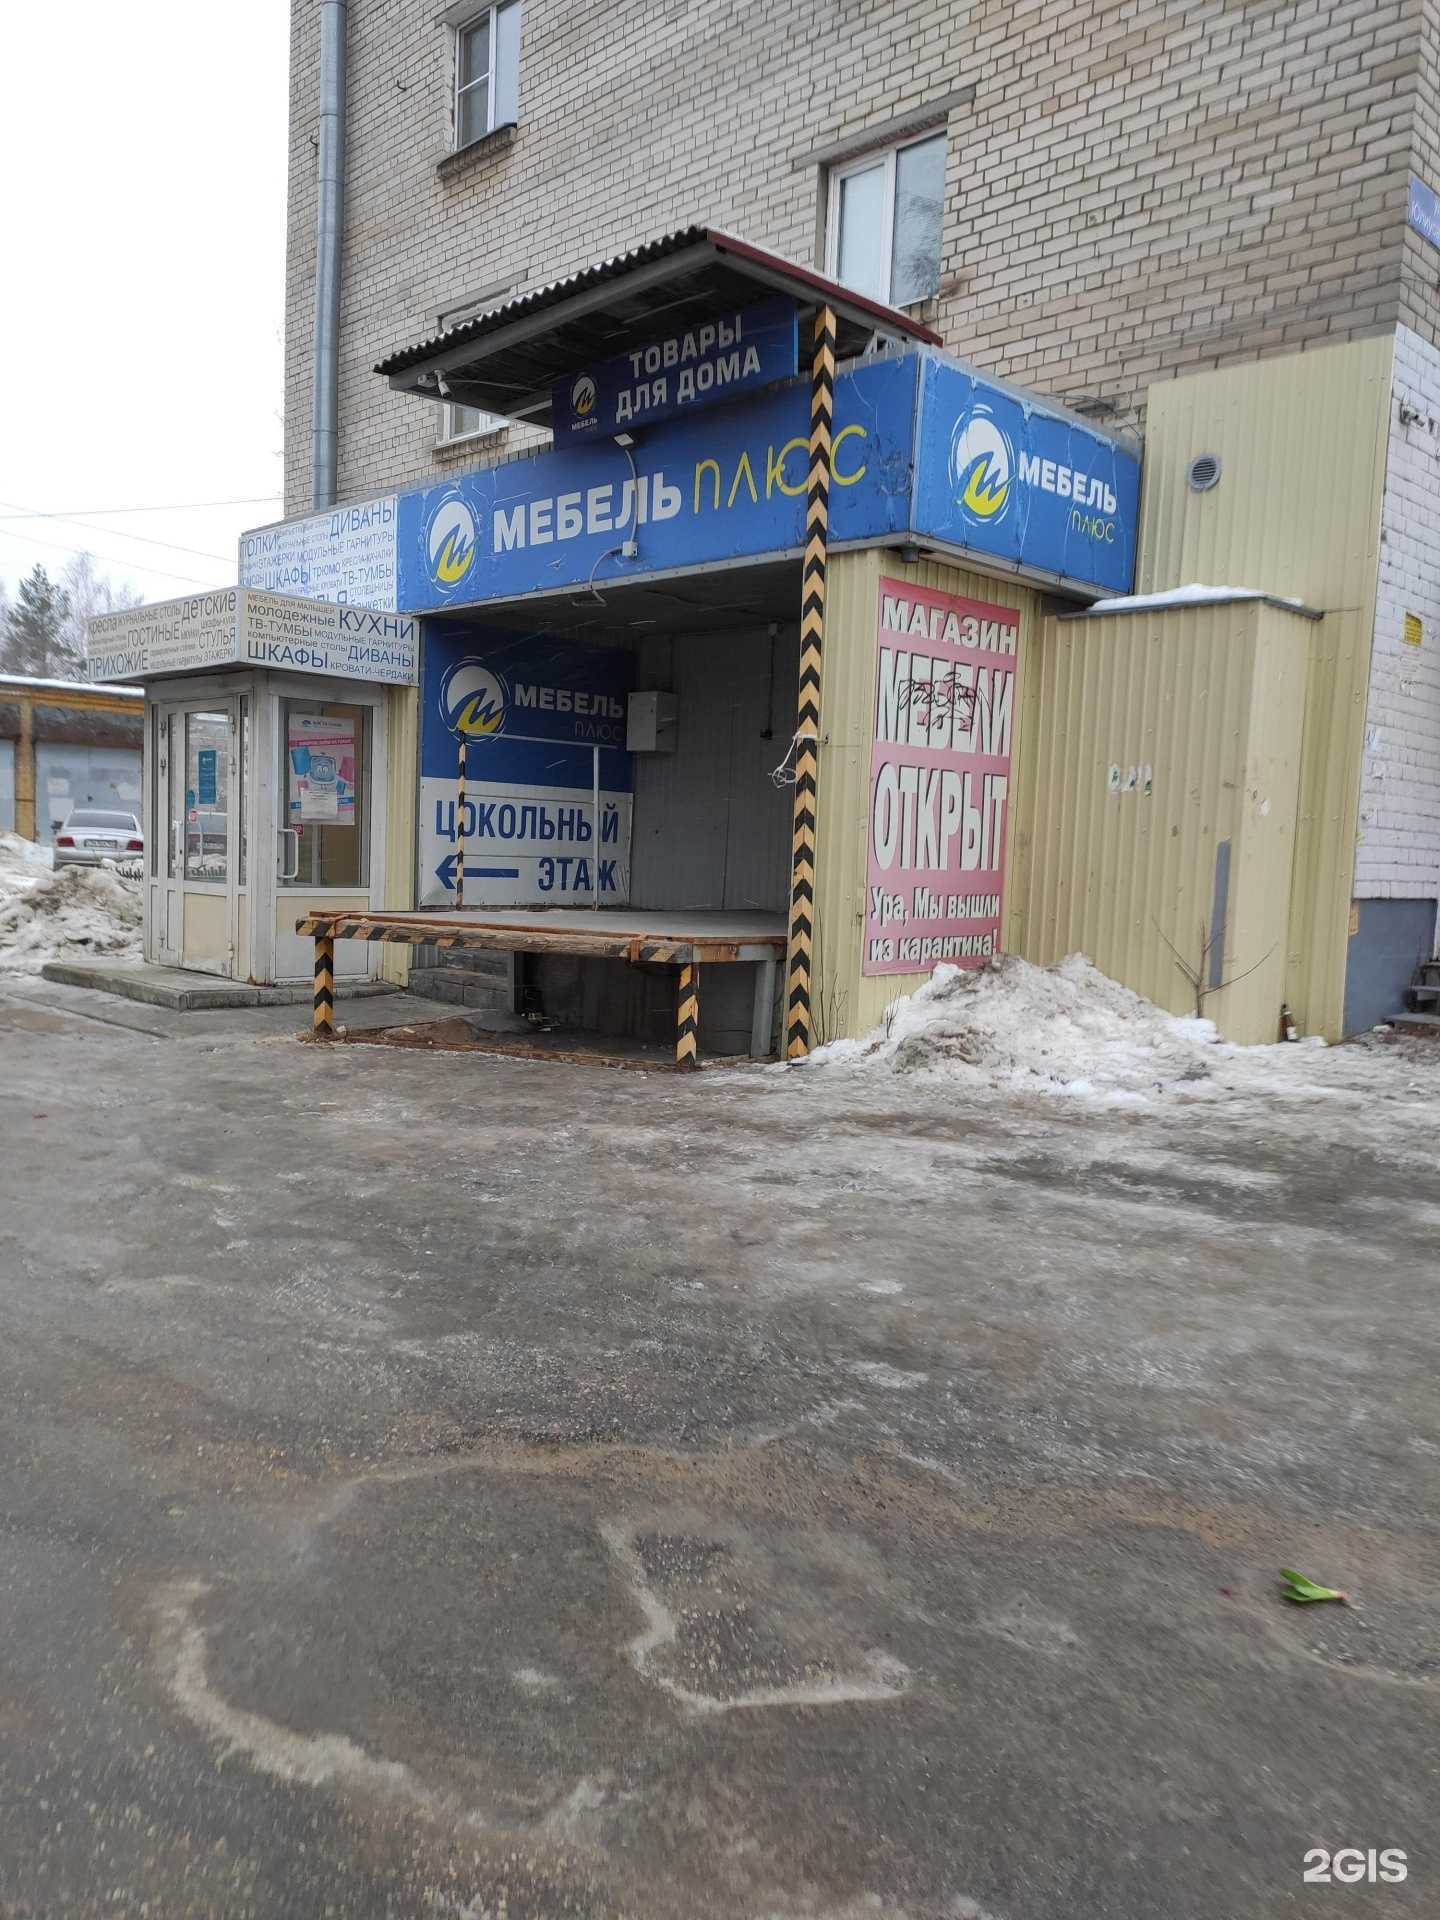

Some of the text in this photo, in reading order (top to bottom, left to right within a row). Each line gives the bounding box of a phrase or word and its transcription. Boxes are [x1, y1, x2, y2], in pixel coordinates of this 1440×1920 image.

[629, 315, 743, 378] ТОВАРЫ
[616, 345, 761, 424] ДЛЯ ДОМА
[571, 417, 598, 431] МЕБЕЛЬ
[493, 424, 867, 553] МЕБЕЛЬ ПЛЮС
[1018, 450, 1117, 514] МЕБЕЛЬ
[330, 498, 395, 541] ДИВАНЫ
[1072, 509, 1115, 544] ПЛЮС
[297, 540, 344, 564] МОДУЛЬНЫЕ
[346, 528, 395, 550] ГАРНИТУРЫ
[264, 562, 311, 591] ШКАФЫ
[343, 561, 394, 585] ТВ-ТУМБЫ
[181, 591, 237, 626] детские
[248, 593, 335, 615] МЕБЕЛЬ ДЛЯ МАЛЫШЕЙ
[127, 621, 181, 648] ГОСТИНЫЕ
[199, 626, 236, 649] СТУЛЬЯ
[248, 616, 414, 652] ТВ-ТУМБЫ МОДУЛЬНЫЕ ГАРНИТУРЫ
[339, 609, 414, 641] КУХНИ
[881, 595, 1018, 657] МАГАЗИН
[88, 649, 149, 680] ПРИХОЖИЕ
[247, 640, 414, 682] ШКАФЫ КРОВАТИ-ЧЕРДАКИ
[347, 645, 414, 668] ДИВАНЫ
[514, 683, 624, 718] МЕБЕЛЬ
[875, 646, 1015, 758] МЕБЕЛИ
[435, 800, 619, 844] ЦОКОЛЬНЫЙ
[873, 761, 1008, 872] ОТКРЫТ
[537, 856, 617, 892] ЭТАЖ
[870, 884, 1000, 928] Ура, Мы вышли
[869, 927, 999, 968] из карантина!
